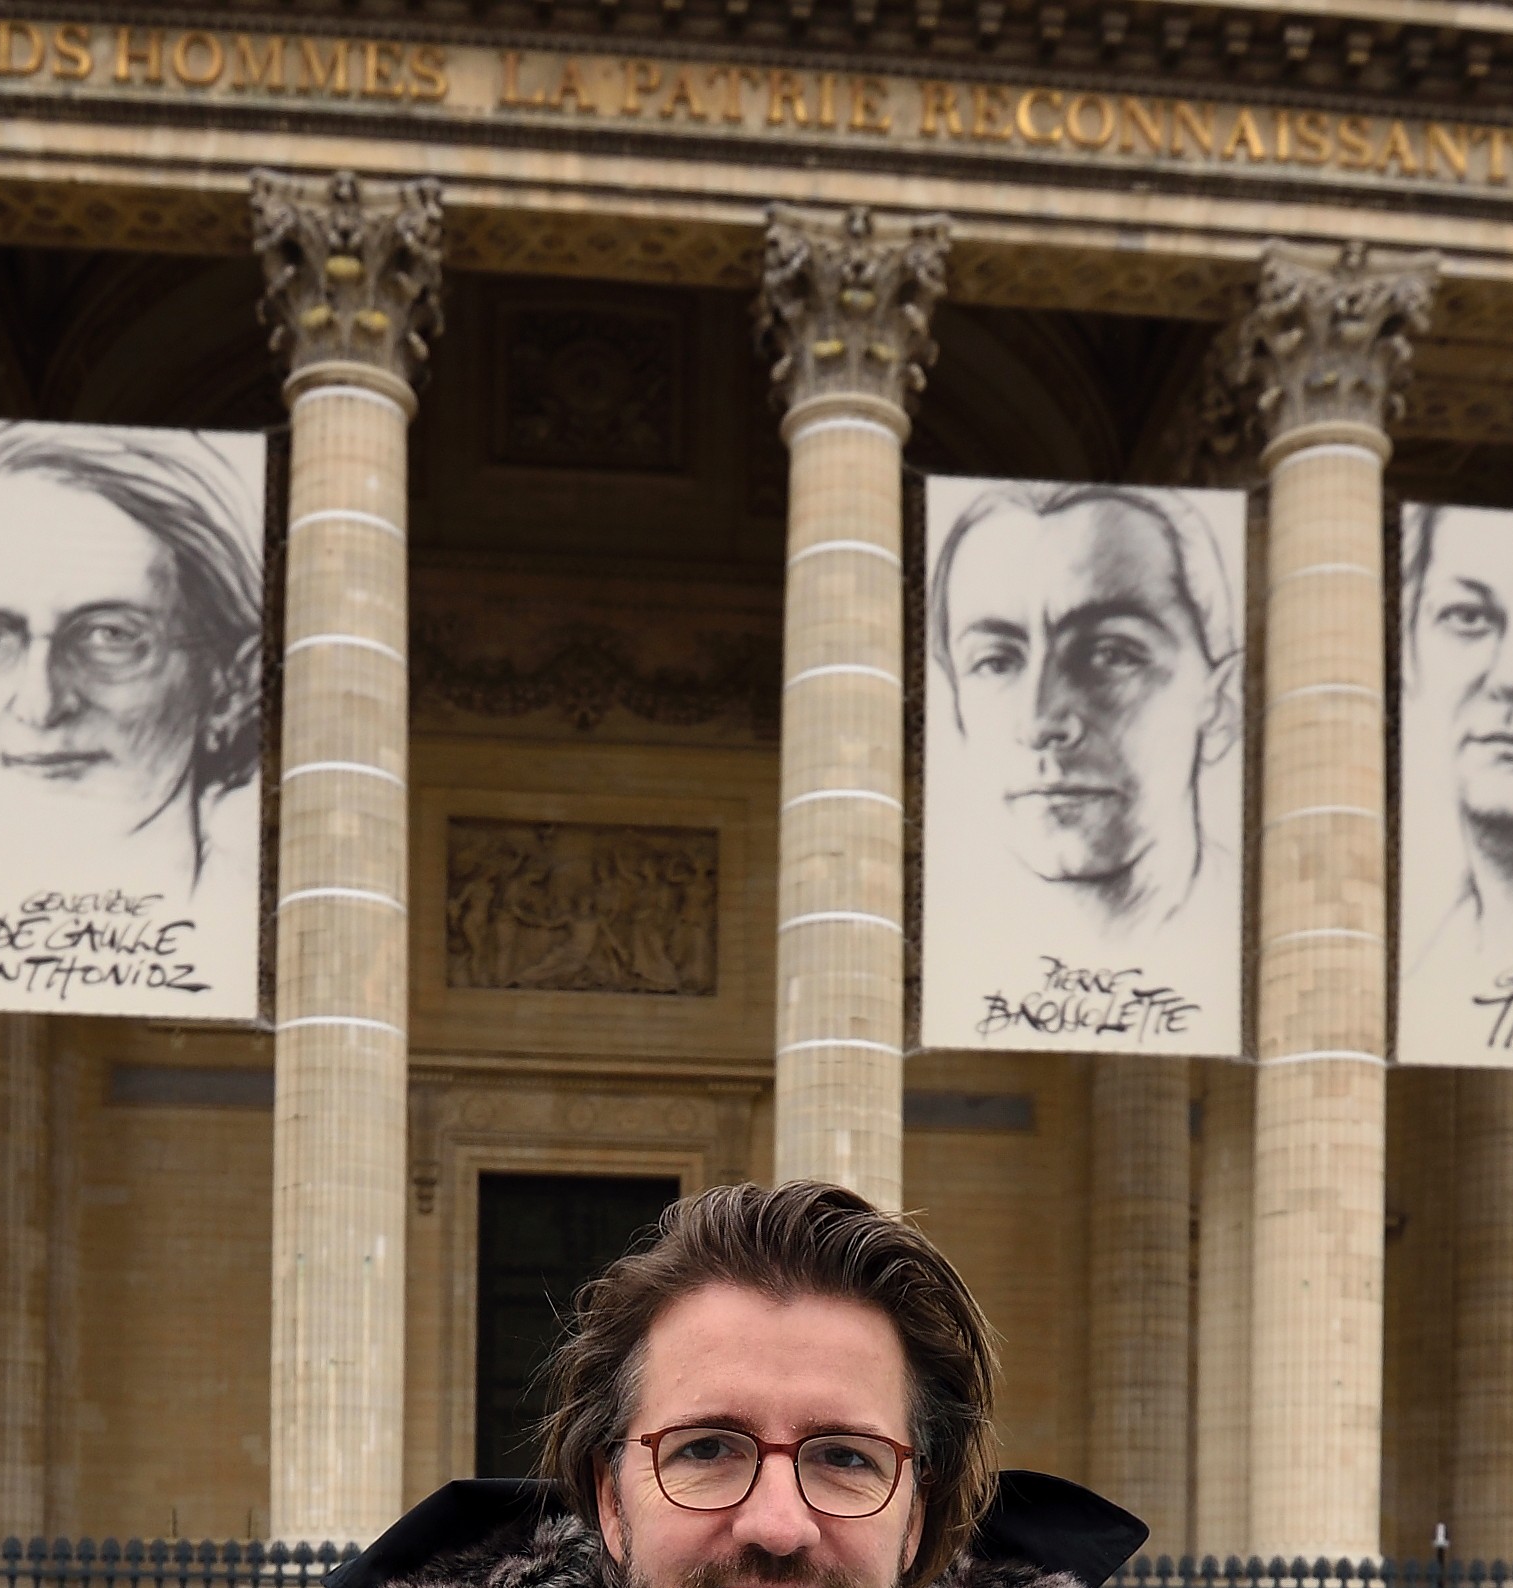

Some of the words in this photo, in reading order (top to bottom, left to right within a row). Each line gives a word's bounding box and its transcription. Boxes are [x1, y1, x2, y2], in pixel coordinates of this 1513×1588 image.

[112, 25, 450, 100] HOMMES
[497, 50, 596, 114] LA
[618, 58, 890, 132] PATRIE
[45, 918, 197, 955] GAULLE
